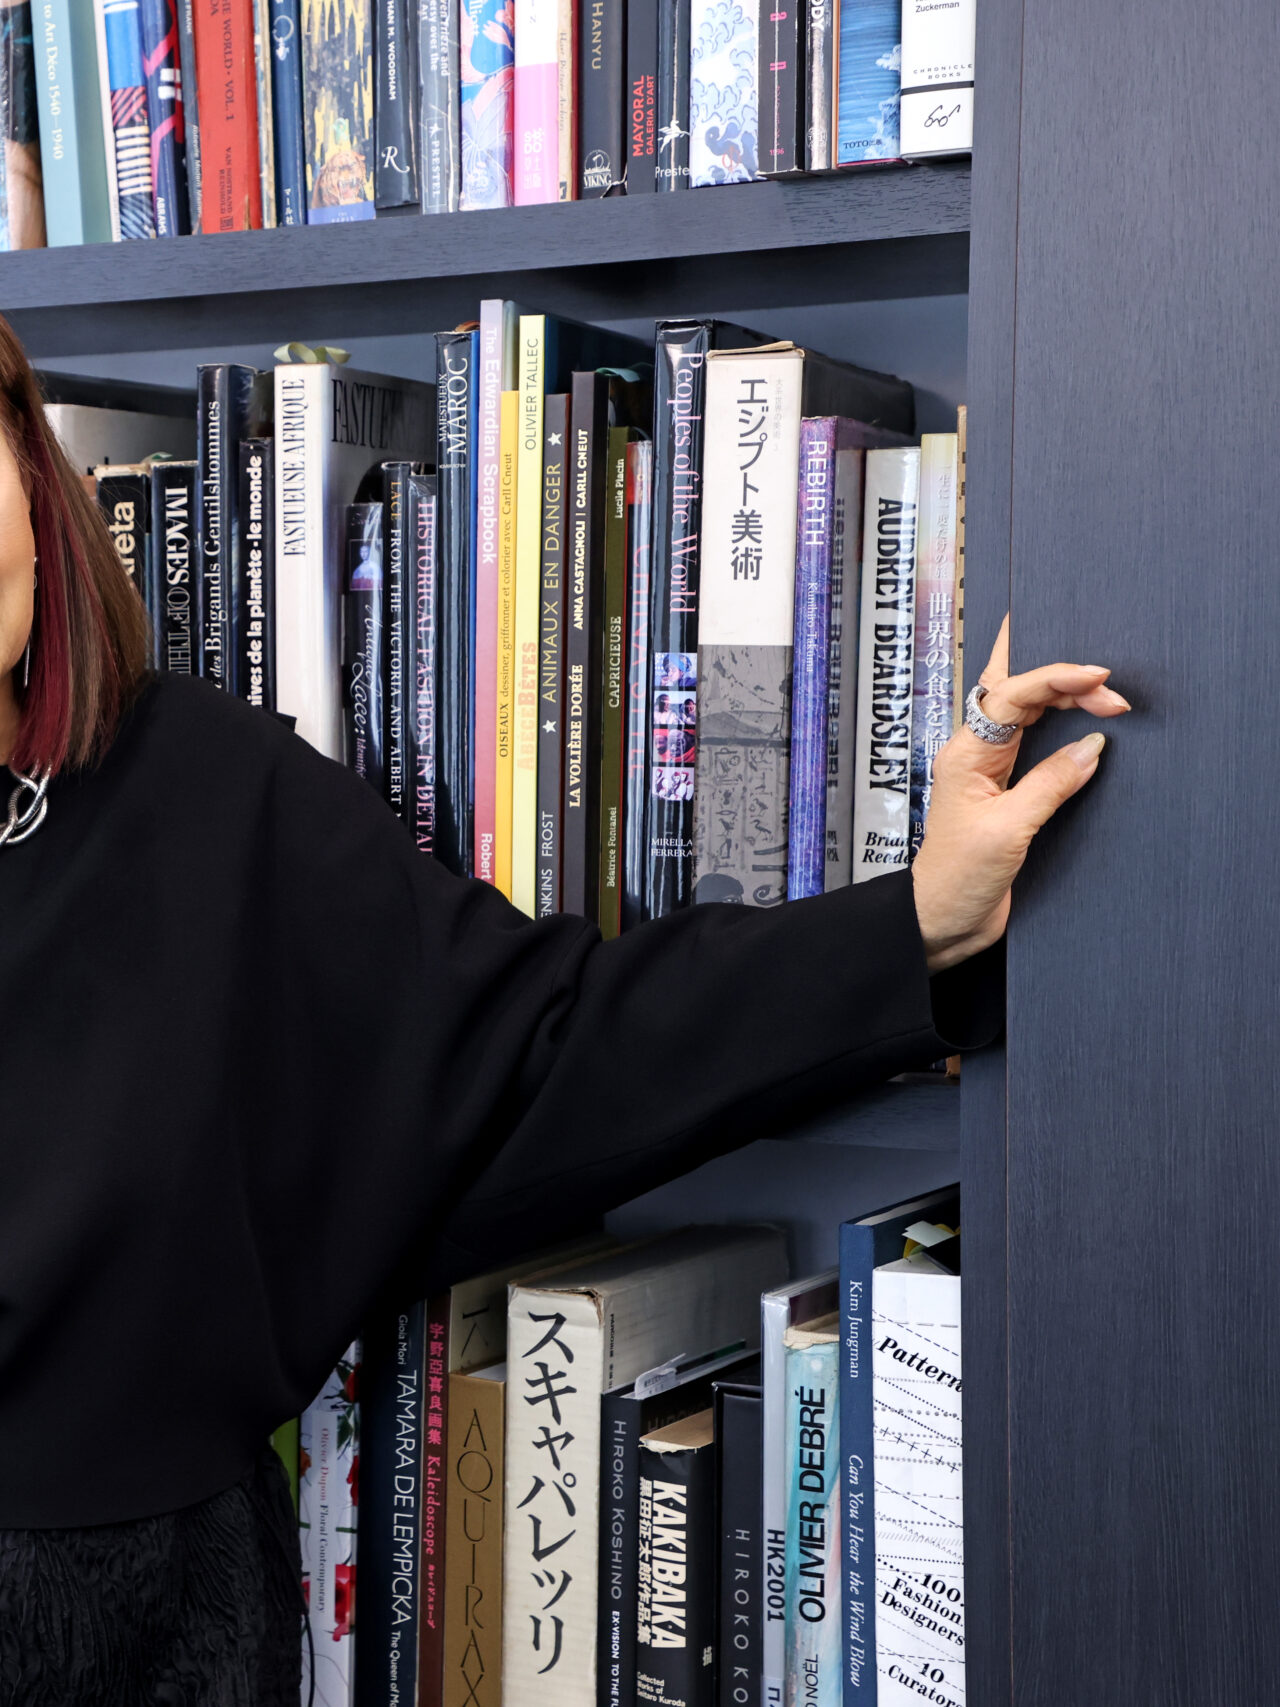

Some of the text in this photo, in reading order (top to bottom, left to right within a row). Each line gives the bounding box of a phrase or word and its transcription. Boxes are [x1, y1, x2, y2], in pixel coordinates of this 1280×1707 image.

[44, 22, 61, 81] Art Déco
[590, 2, 604, 71] HANYU
[915, 2, 961, 14] Zuckerman
[221, 18, 237, 113] WORLD VOL.
[386, 27, 399, 101] M. WOODHAM
[430, 49, 441, 71] the
[440, 54, 452, 77] and
[912, 63, 973, 75] CHRONICLE
[927, 72, 962, 80] BOOKS
[631, 78, 646, 157] MAYORAL
[645, 75, 656, 156] GALERIA D'ART
[155, 196, 168, 235] ABRAMS
[430, 139, 442, 199] PRESTEL
[437, 373, 449, 443] MAJESTUEUX
[446, 357, 469, 456] MAROC
[524, 337, 539, 452] OLIVIER TALLEC
[280, 378, 309, 557] FASTUEUSE AFRIQUE
[479, 327, 501, 565] The Edwardian Scrapbook
[666, 349, 704, 615] Peoples of the World
[730, 378, 769, 581] エジプト美術
[804, 439, 828, 546] REBIRTH
[164, 485, 192, 622] IMAGES OF
[202, 400, 229, 652] Brigands Gentilshommes
[573, 429, 589, 631] ANNA CASTAGNOLI CARLL CNEUT
[614, 493, 627, 520] Lucile
[246, 456, 263, 665] de planète monde
[498, 453, 513, 759] OISEAUX griffonner colorier Carll Cneut
[541, 463, 562, 704] ANIMAUX EN DANGER
[806, 581, 818, 628] Kunihiro
[389, 481, 404, 805] LACE FROM THE VICTORIA AND ALBERT
[415, 501, 435, 778] HISTORICAL FASHION IN
[608, 615, 622, 709] CAPRICIEUSE
[869, 497, 917, 796] AUBREY BEARDSLEY
[565, 664, 584, 809] LA VOLIÈRE DORÉE
[478, 832, 493, 881] Robert
[541, 809, 555, 857] FROST
[396, 1341, 409, 1366] Mori
[847, 1280, 864, 1379] Kim Jungman
[390, 1369, 417, 1625] TAMARA DE LEMPICKA
[423, 1455, 439, 1558] Kaleidoscope
[516, 1310, 580, 1677] スキャパレッリ
[610, 1419, 628, 1600] HIROKO KOSHINO
[794, 1385, 826, 1623] OLIVIER DEBRÉ
[315, 1504, 330, 1614] Floral Contemporary
[456, 1407, 494, 1707] AQUIRAX
[635, 1475, 653, 1646] 黒田征太郎作品集
[733, 1528, 751, 1650] HIROKO
[766, 1528, 786, 1623] HK2001
[847, 1454, 865, 1688] Can You Hear the Wind Blow
[387, 1630, 401, 1680] The Queen
[879, 1590, 965, 1648] Designers
[802, 1653, 819, 1700] NOËL
[919, 1662, 945, 1685] 10
